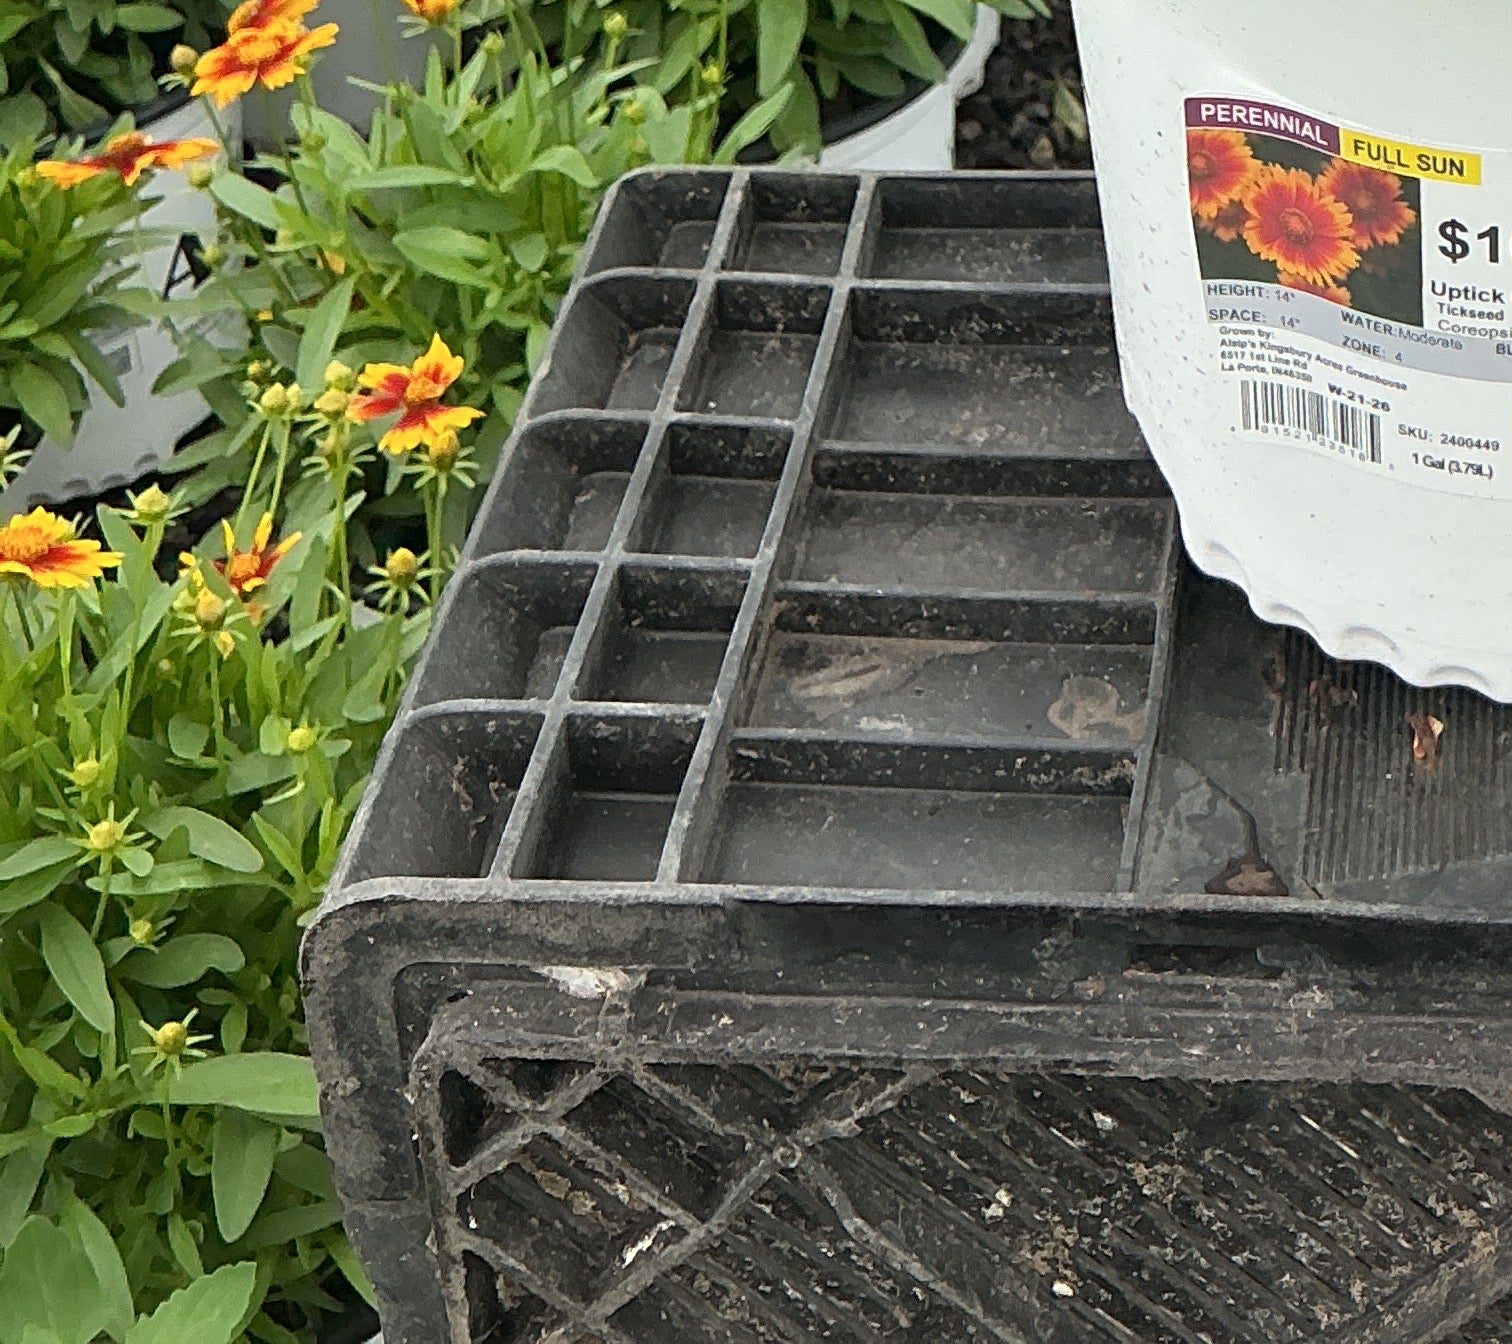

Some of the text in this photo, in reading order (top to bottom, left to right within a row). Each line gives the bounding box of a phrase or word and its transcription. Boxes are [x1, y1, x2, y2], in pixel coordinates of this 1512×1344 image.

[1200, 103, 1329, 146] PERENNIAL
[1353, 138, 1465, 177] FULL SUN
[1207, 283, 1270, 300] HEIGHT:
[1430, 280, 1505, 305] Uptick
[1208, 308, 1266, 324] SPACE:
[1437, 302, 1505, 322] Tickseed
[1219, 325, 1256, 336] Grown
[1340, 310, 1463, 351] WATER: Moderate
[1341, 335, 1403, 363] ZONE: 4
[1397, 423, 1433, 443] SKU:
[1411, 452, 1419, 465] 1
[1421, 454, 1446, 470] Gal
